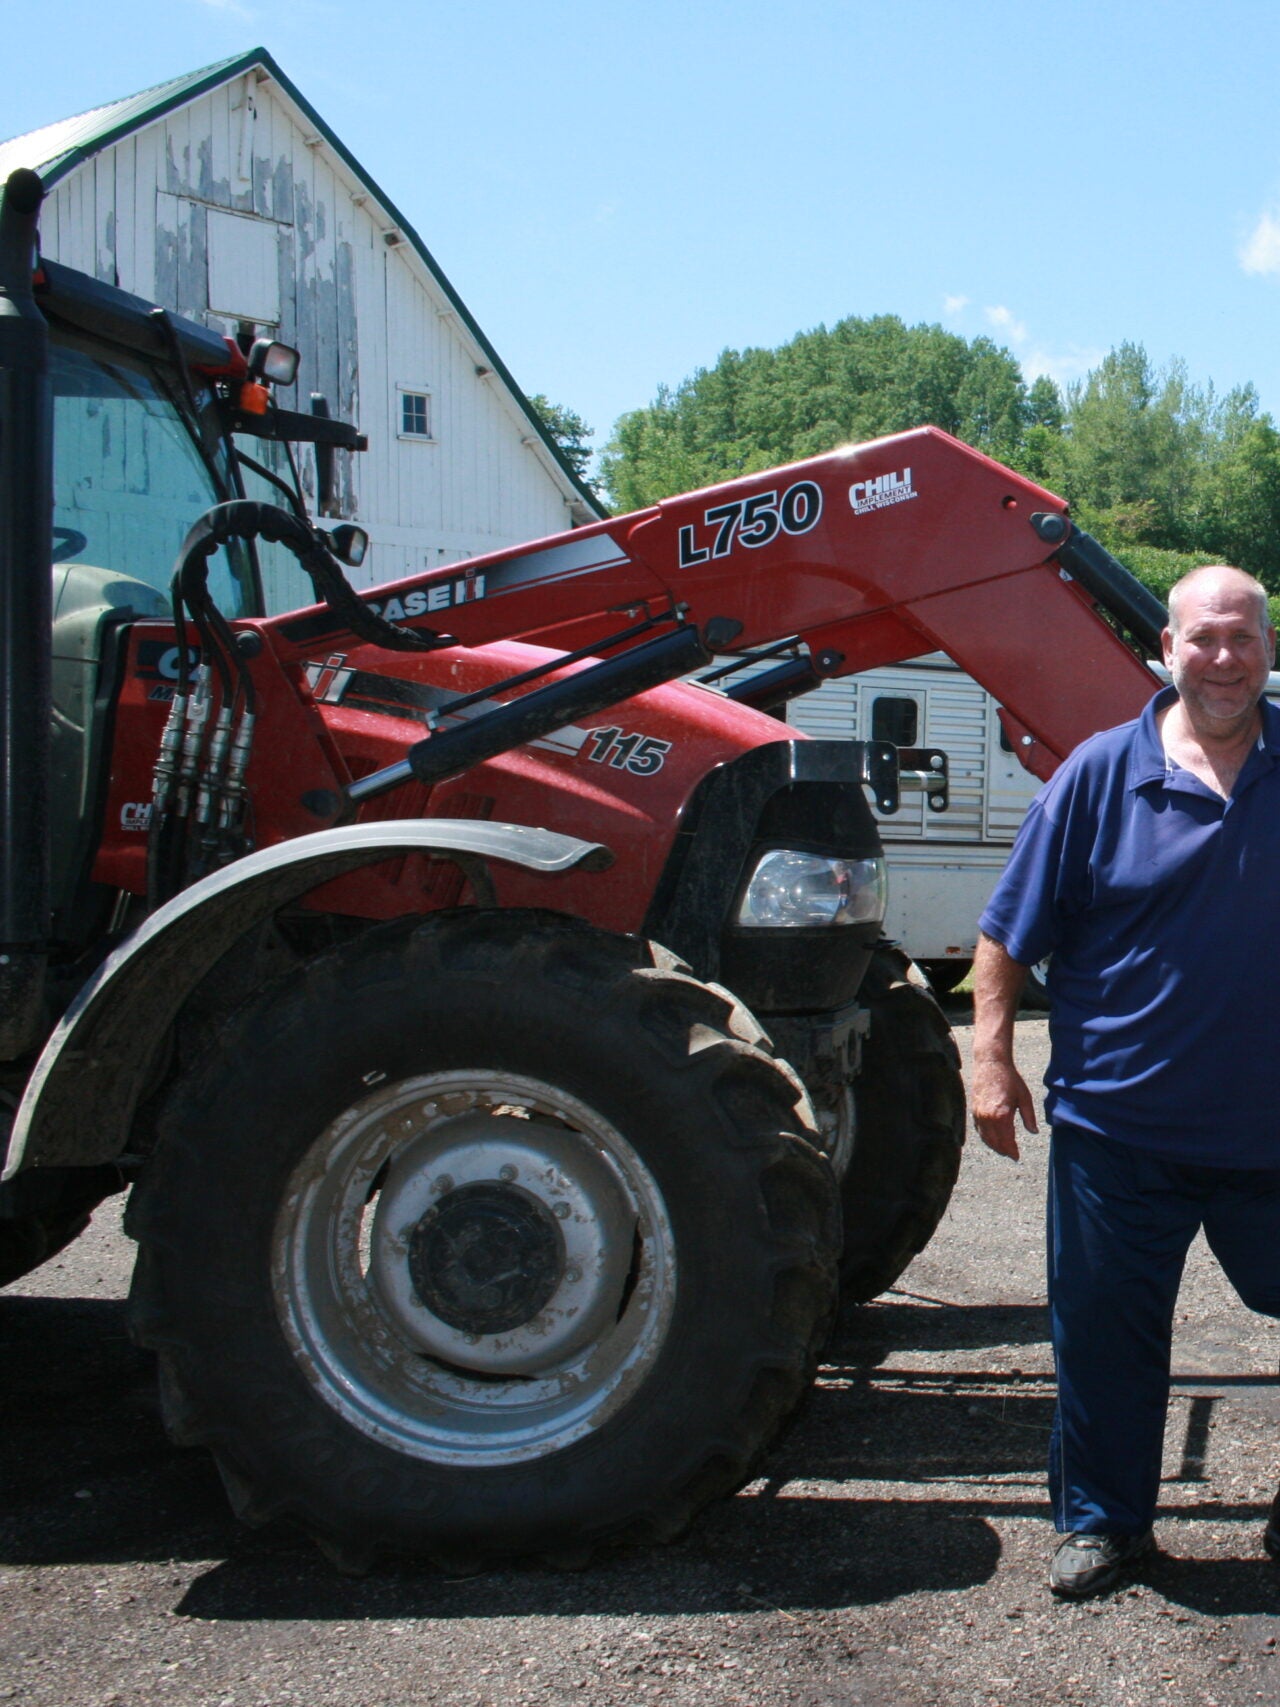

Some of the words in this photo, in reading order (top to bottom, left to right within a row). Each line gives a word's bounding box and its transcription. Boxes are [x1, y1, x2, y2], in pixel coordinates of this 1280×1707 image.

[849, 467, 911, 510] CHILI
[857, 485, 912, 508] IMPLEMENT
[876, 491, 918, 509] WISCONSIN
[678, 480, 823, 569] L750
[588, 726, 673, 776] 115
